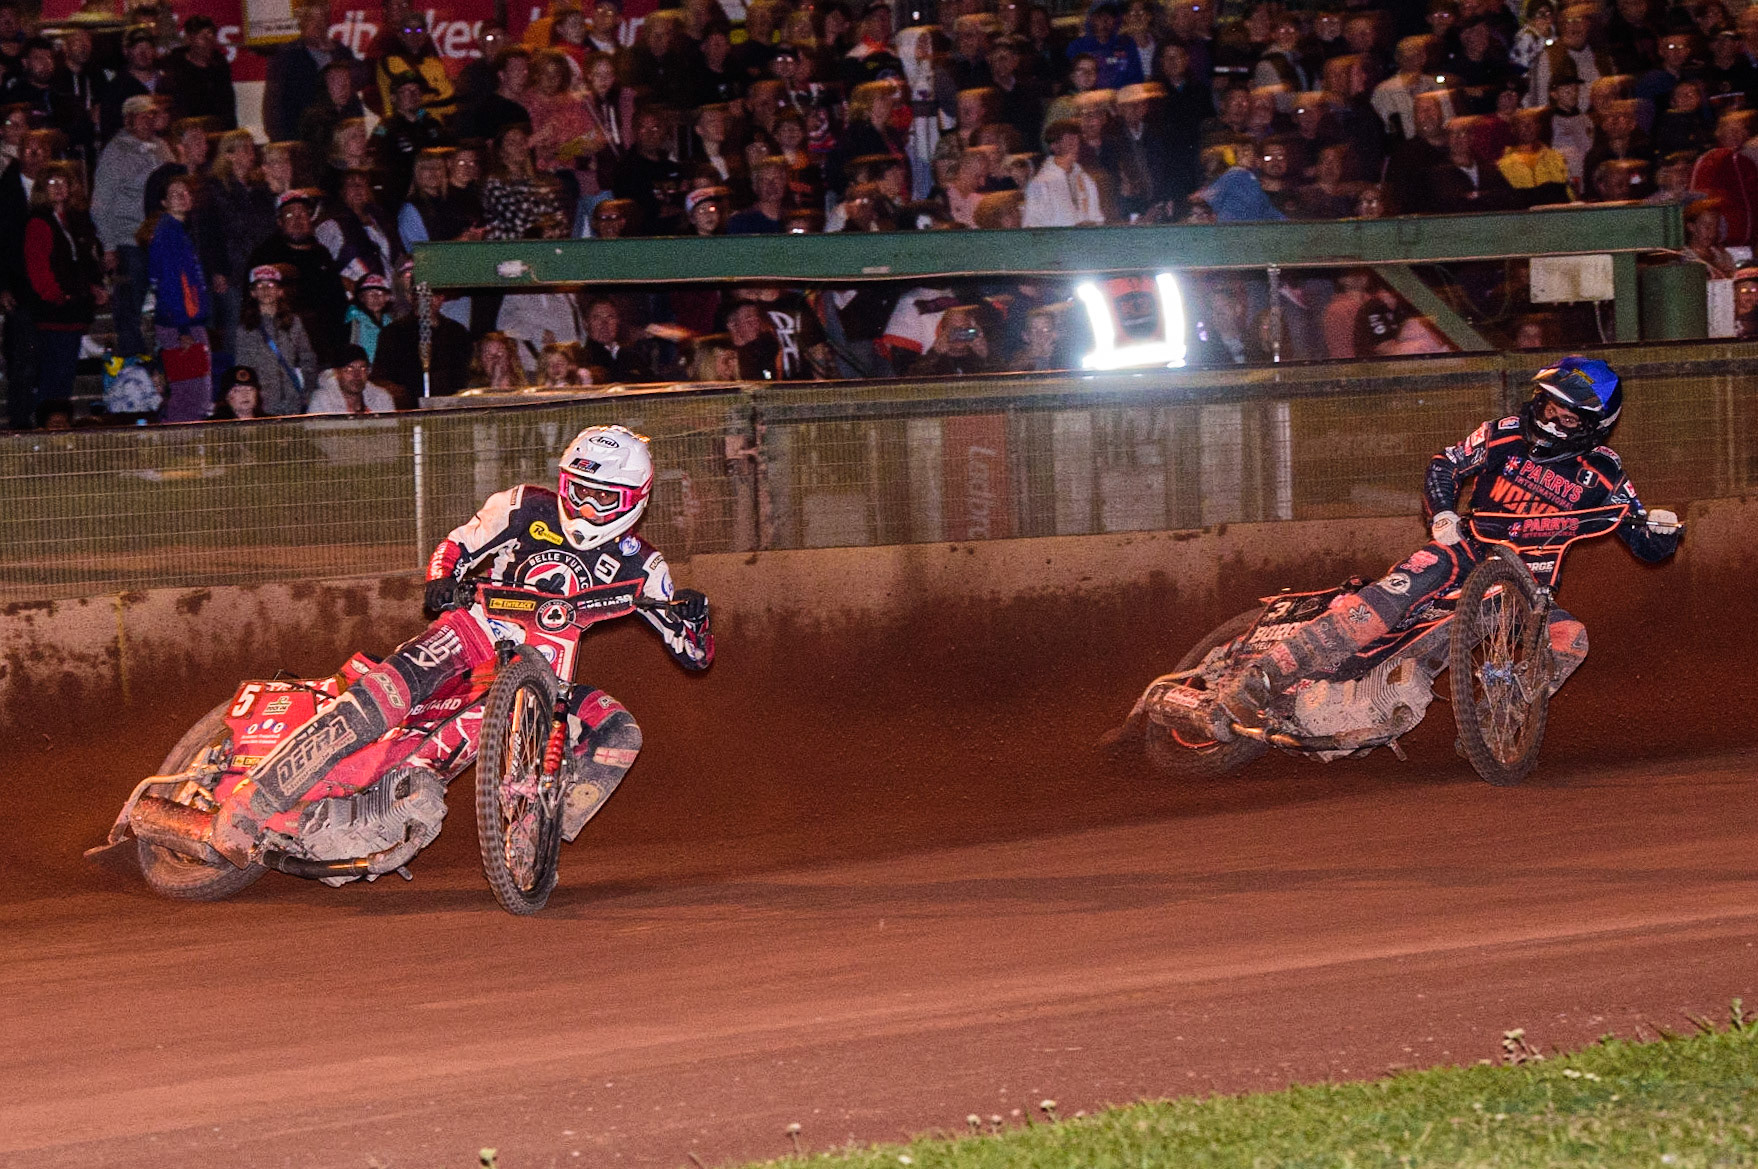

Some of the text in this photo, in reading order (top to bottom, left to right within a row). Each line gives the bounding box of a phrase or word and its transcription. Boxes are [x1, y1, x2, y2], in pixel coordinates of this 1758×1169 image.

[596, 436, 617, 447] Arai
[1519, 459, 1584, 503] PARRYS
[1582, 470, 1594, 486] 3
[1522, 517, 1580, 533] PARRYS
[528, 553, 561, 567] BELLE
[564, 555, 583, 574] VUE
[596, 558, 616, 578] 5
[1268, 601, 1293, 618] 3
[230, 683, 262, 717] 5
